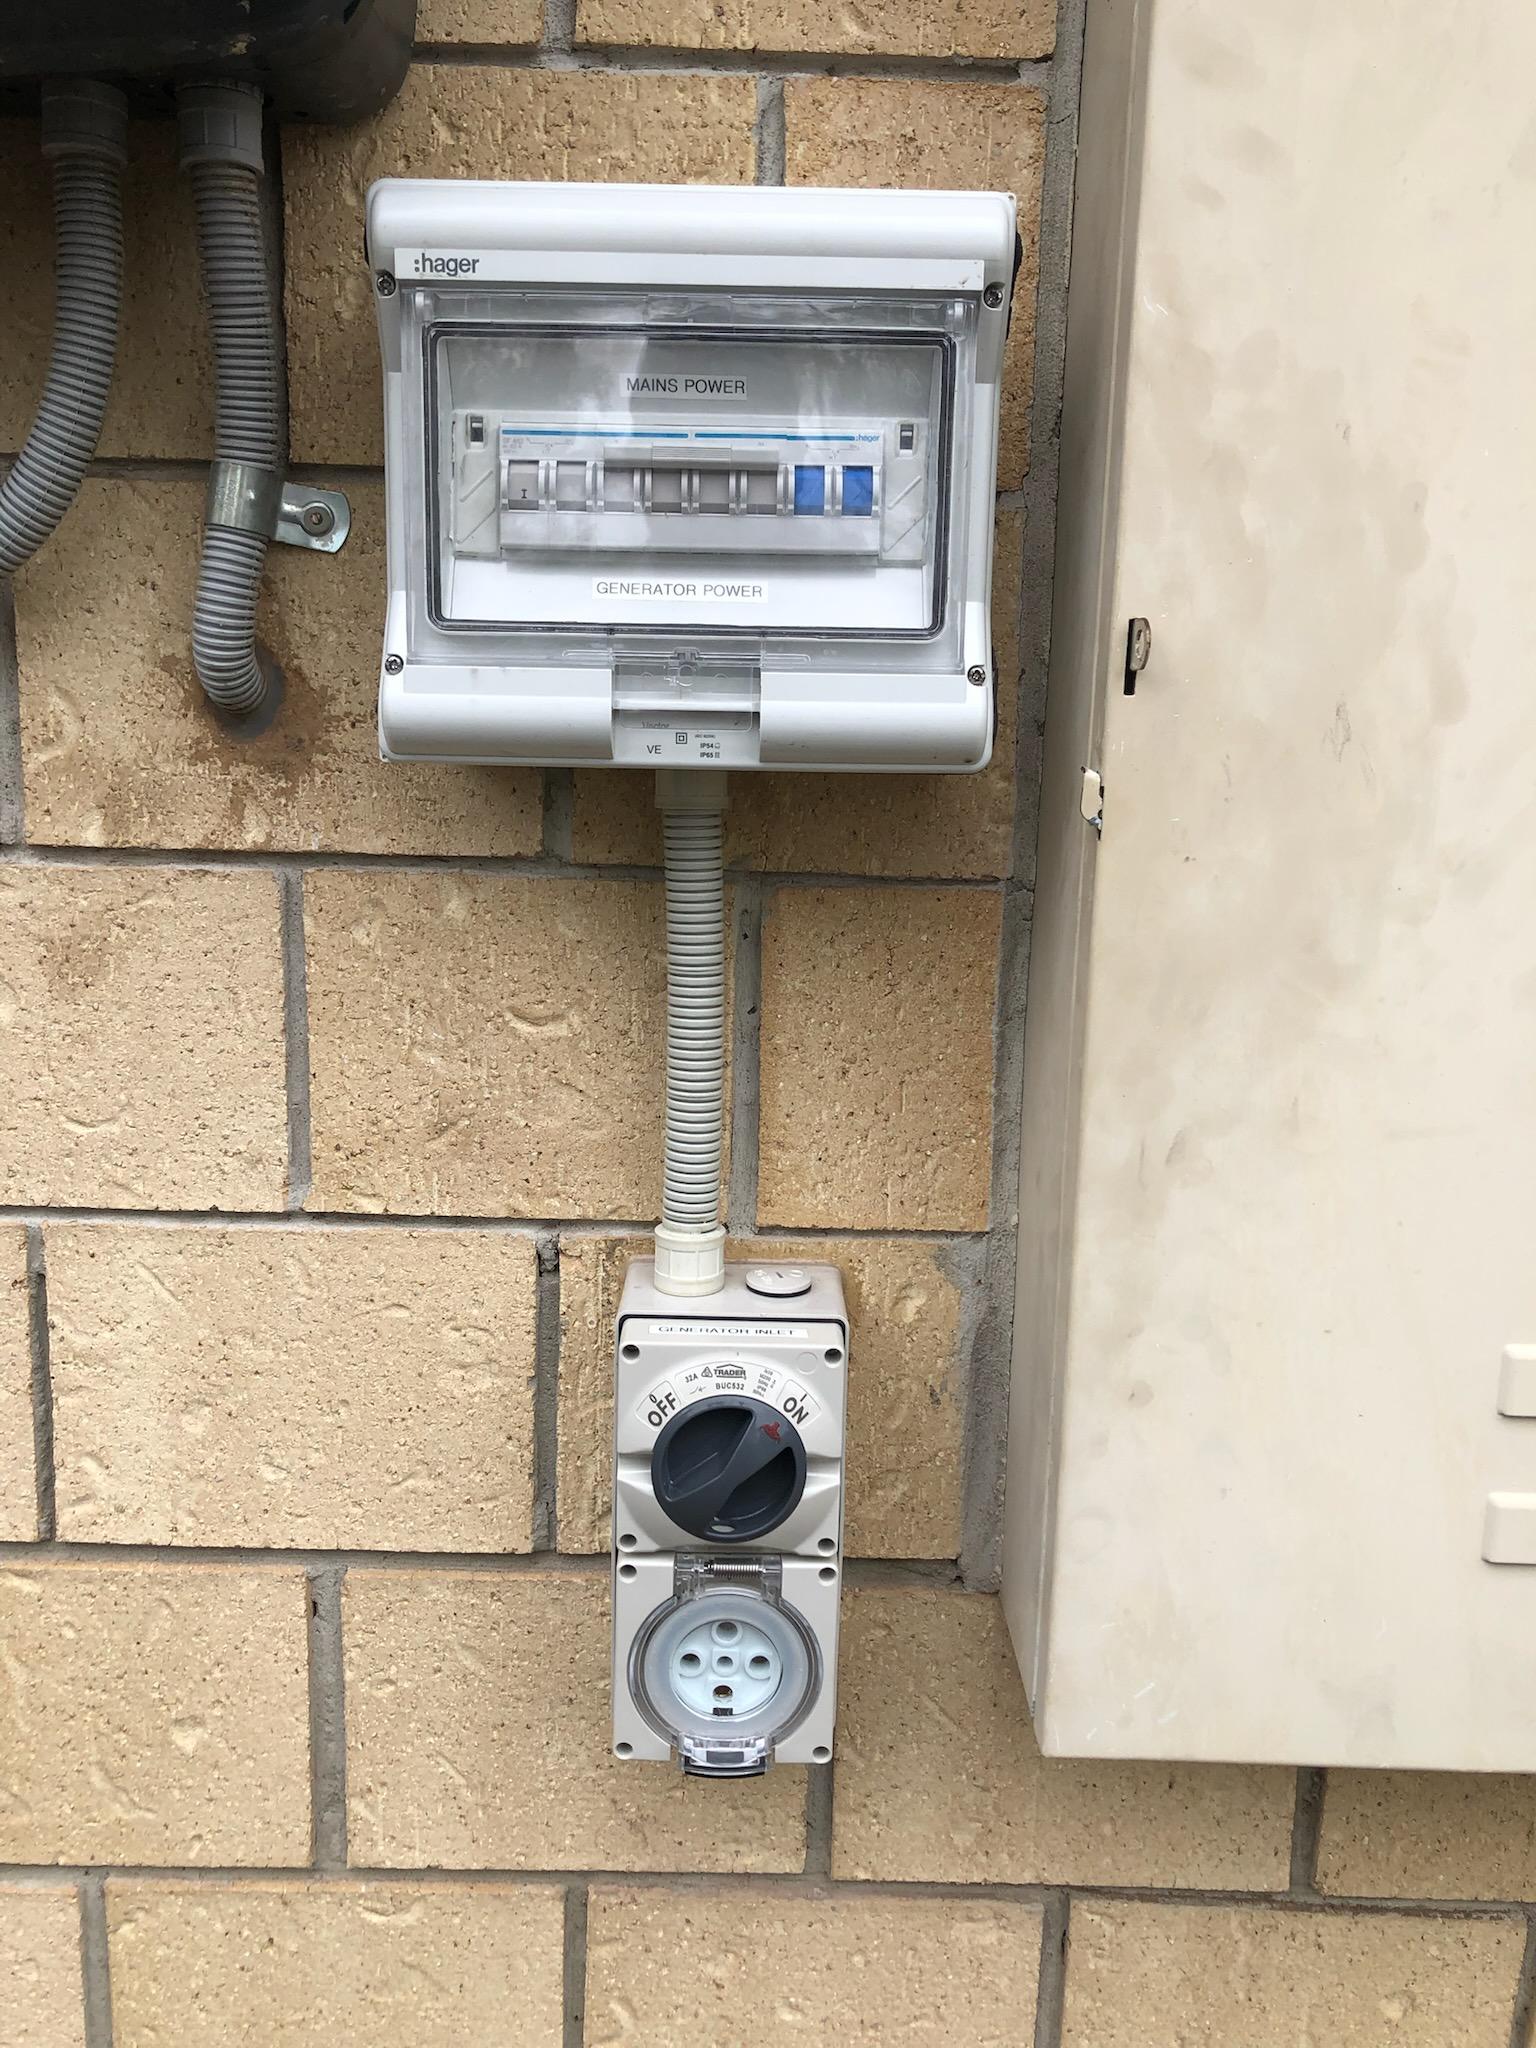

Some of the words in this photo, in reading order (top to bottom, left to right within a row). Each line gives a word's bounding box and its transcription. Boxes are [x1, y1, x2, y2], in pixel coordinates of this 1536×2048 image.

[626, 377, 679, 393] MAINS
[684, 379, 745, 394] POWER
[596, 581, 697, 597] GENERATOR
[703, 584, 763, 598] POWER
[646, 744, 663, 755] VE
[658, 1326, 749, 1335] GENERATOR
[713, 1368, 746, 1377] TRADER
[685, 1373, 699, 1384] 32A
[715, 1382, 745, 1391] BUC532
[647, 1392, 677, 1427] OFF
[783, 1397, 809, 1425] ON
